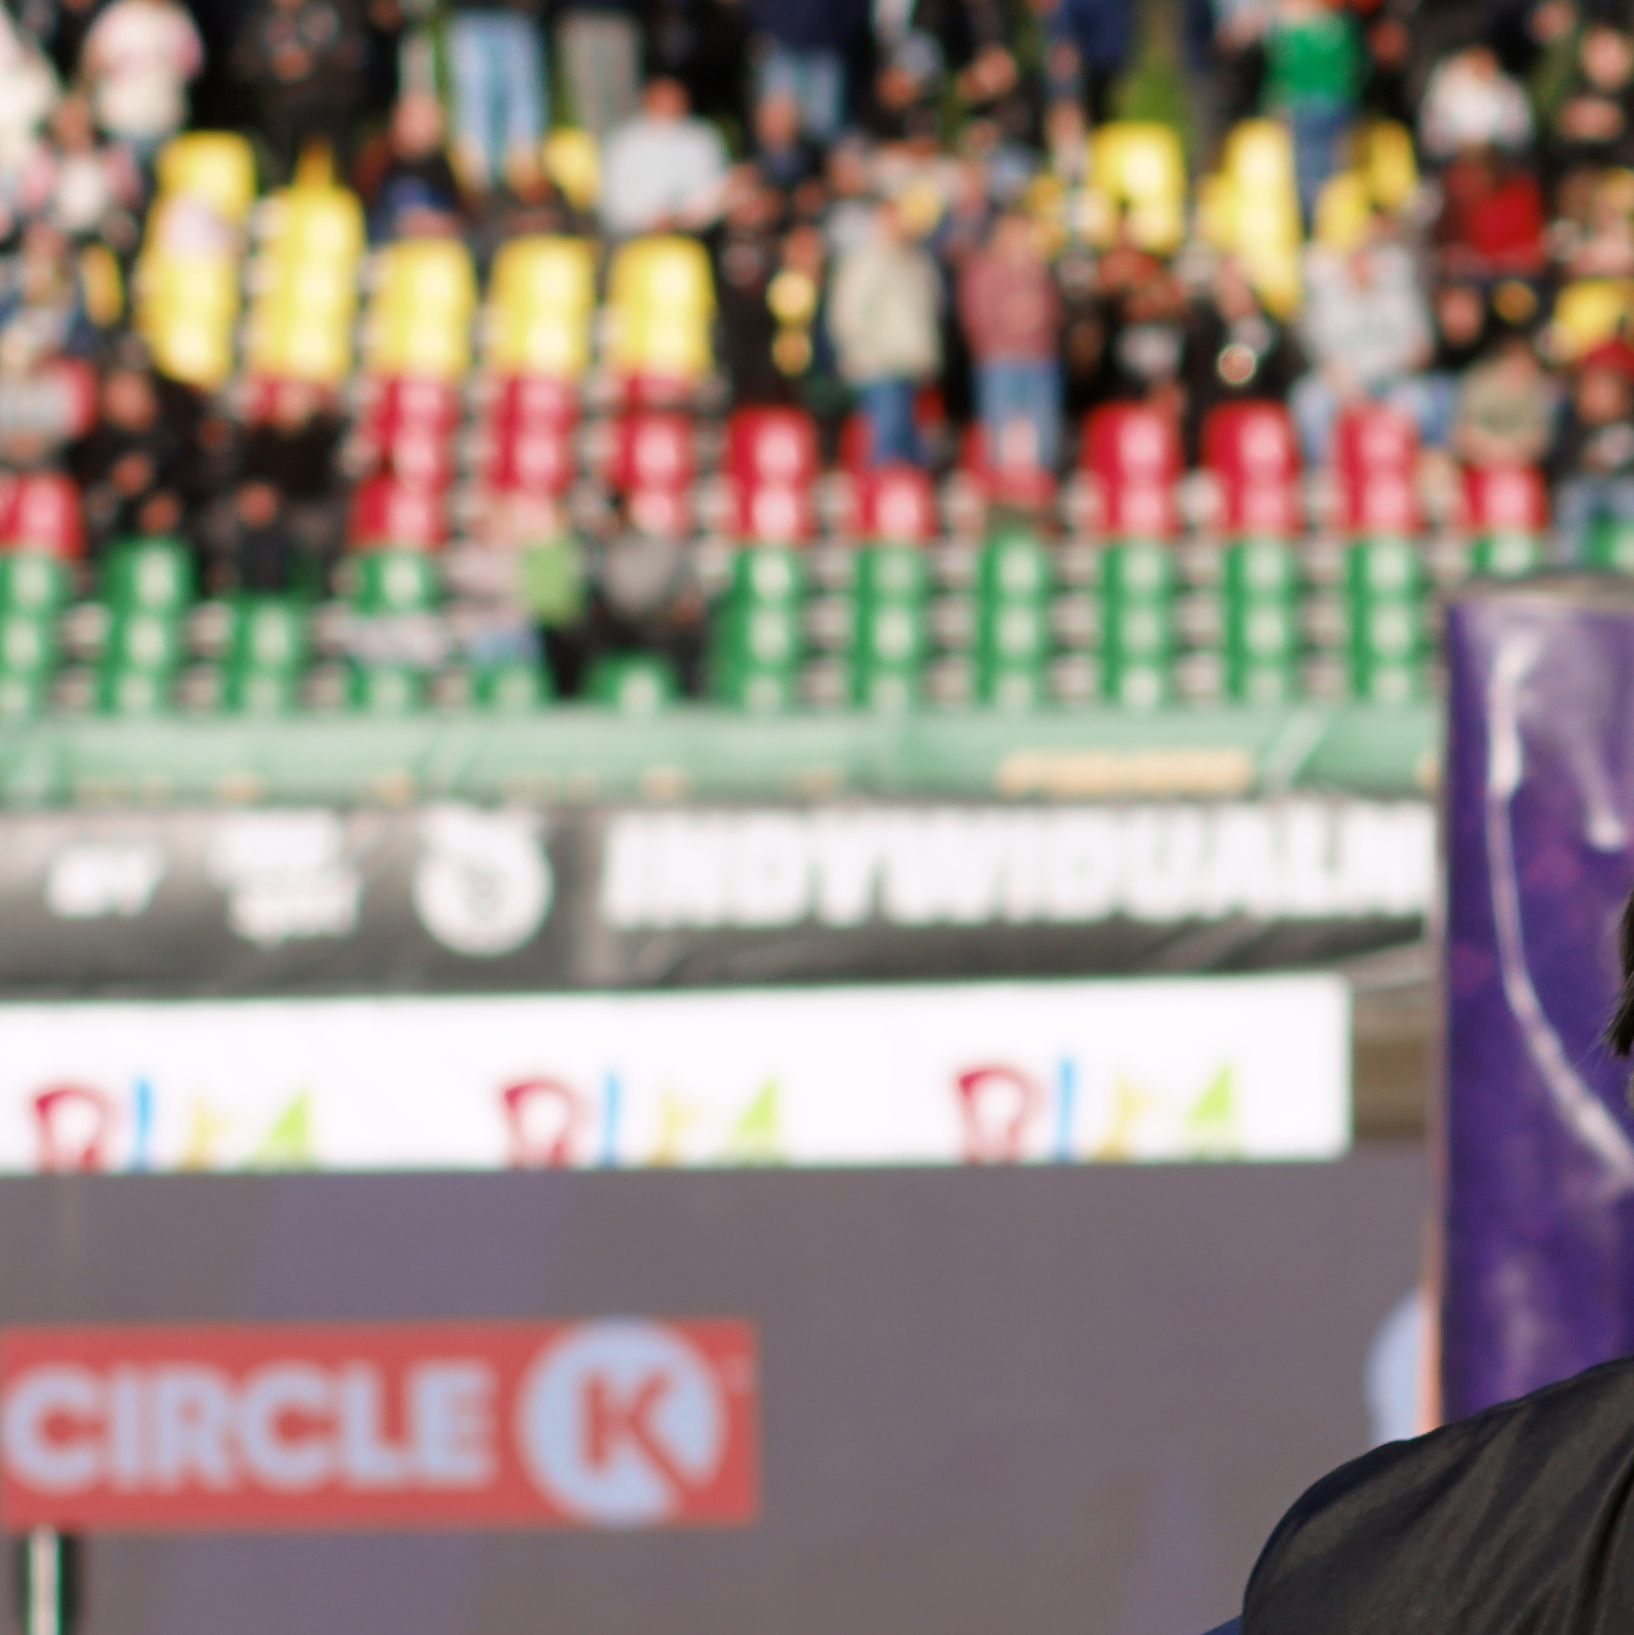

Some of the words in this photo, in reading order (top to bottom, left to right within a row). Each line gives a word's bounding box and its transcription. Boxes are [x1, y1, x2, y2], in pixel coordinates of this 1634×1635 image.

[603, 806, 1437, 926] INDYWIDUALN
[3, 1360, 499, 1493] CIRCLE
[540, 1333, 727, 1528] K
